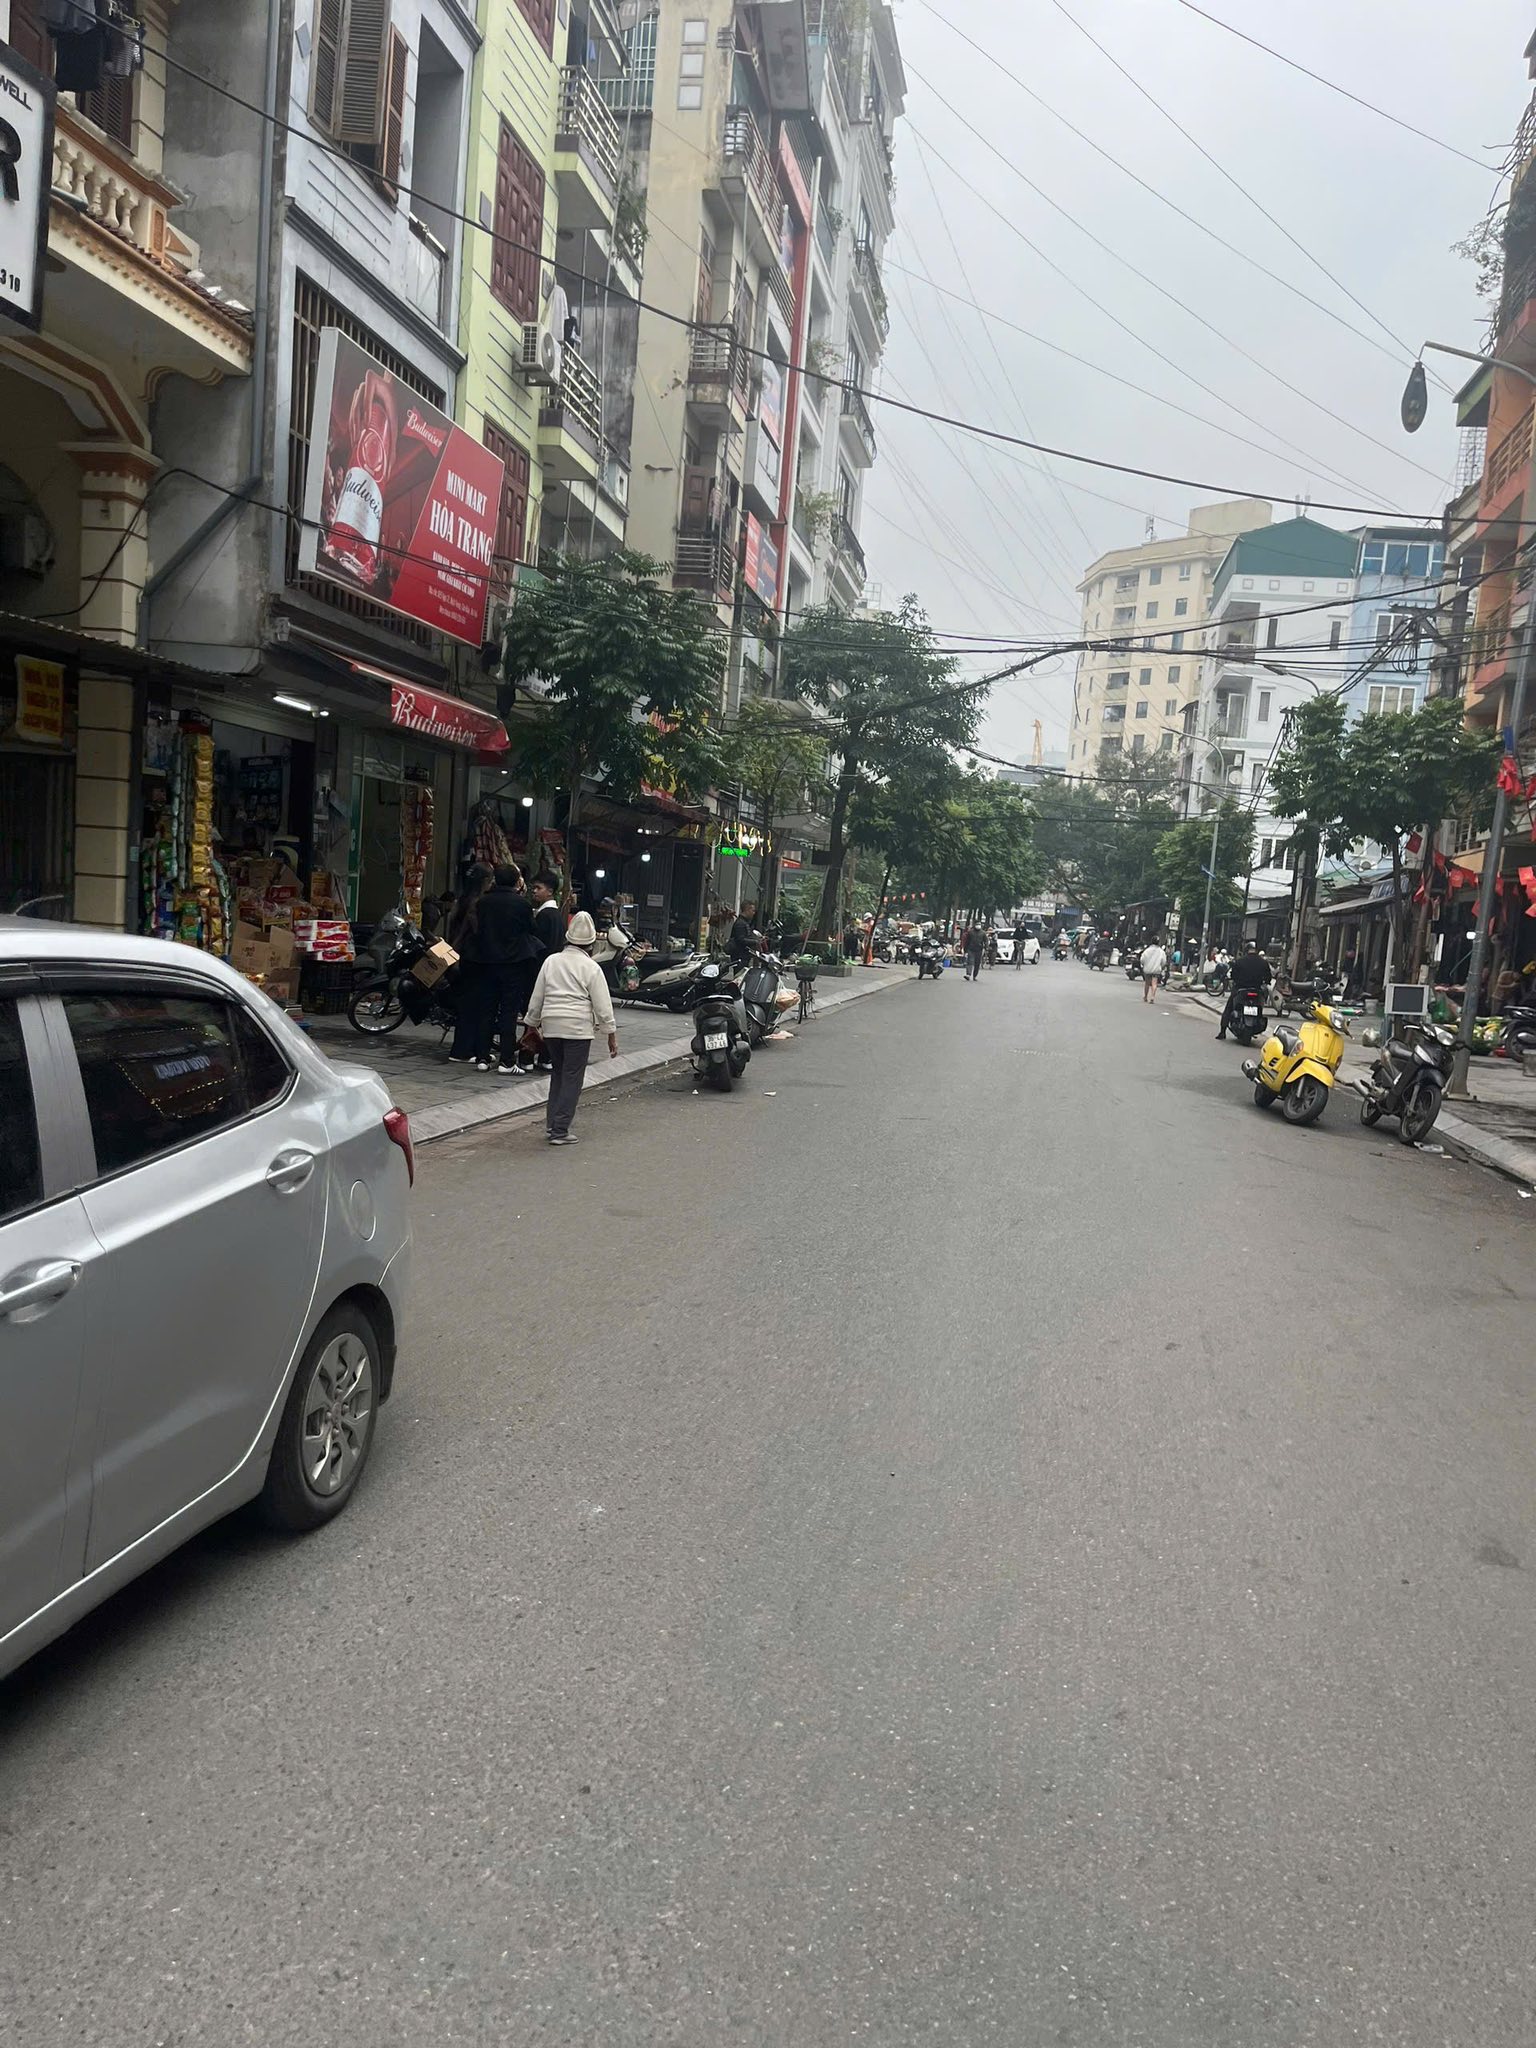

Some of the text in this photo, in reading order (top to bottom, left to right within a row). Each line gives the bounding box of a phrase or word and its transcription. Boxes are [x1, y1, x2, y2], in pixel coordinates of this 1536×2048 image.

[407, 409, 443, 448] Budweiser
[446, 469, 488, 517] MINI MART
[429, 499, 493, 567] HÒA TRANG
